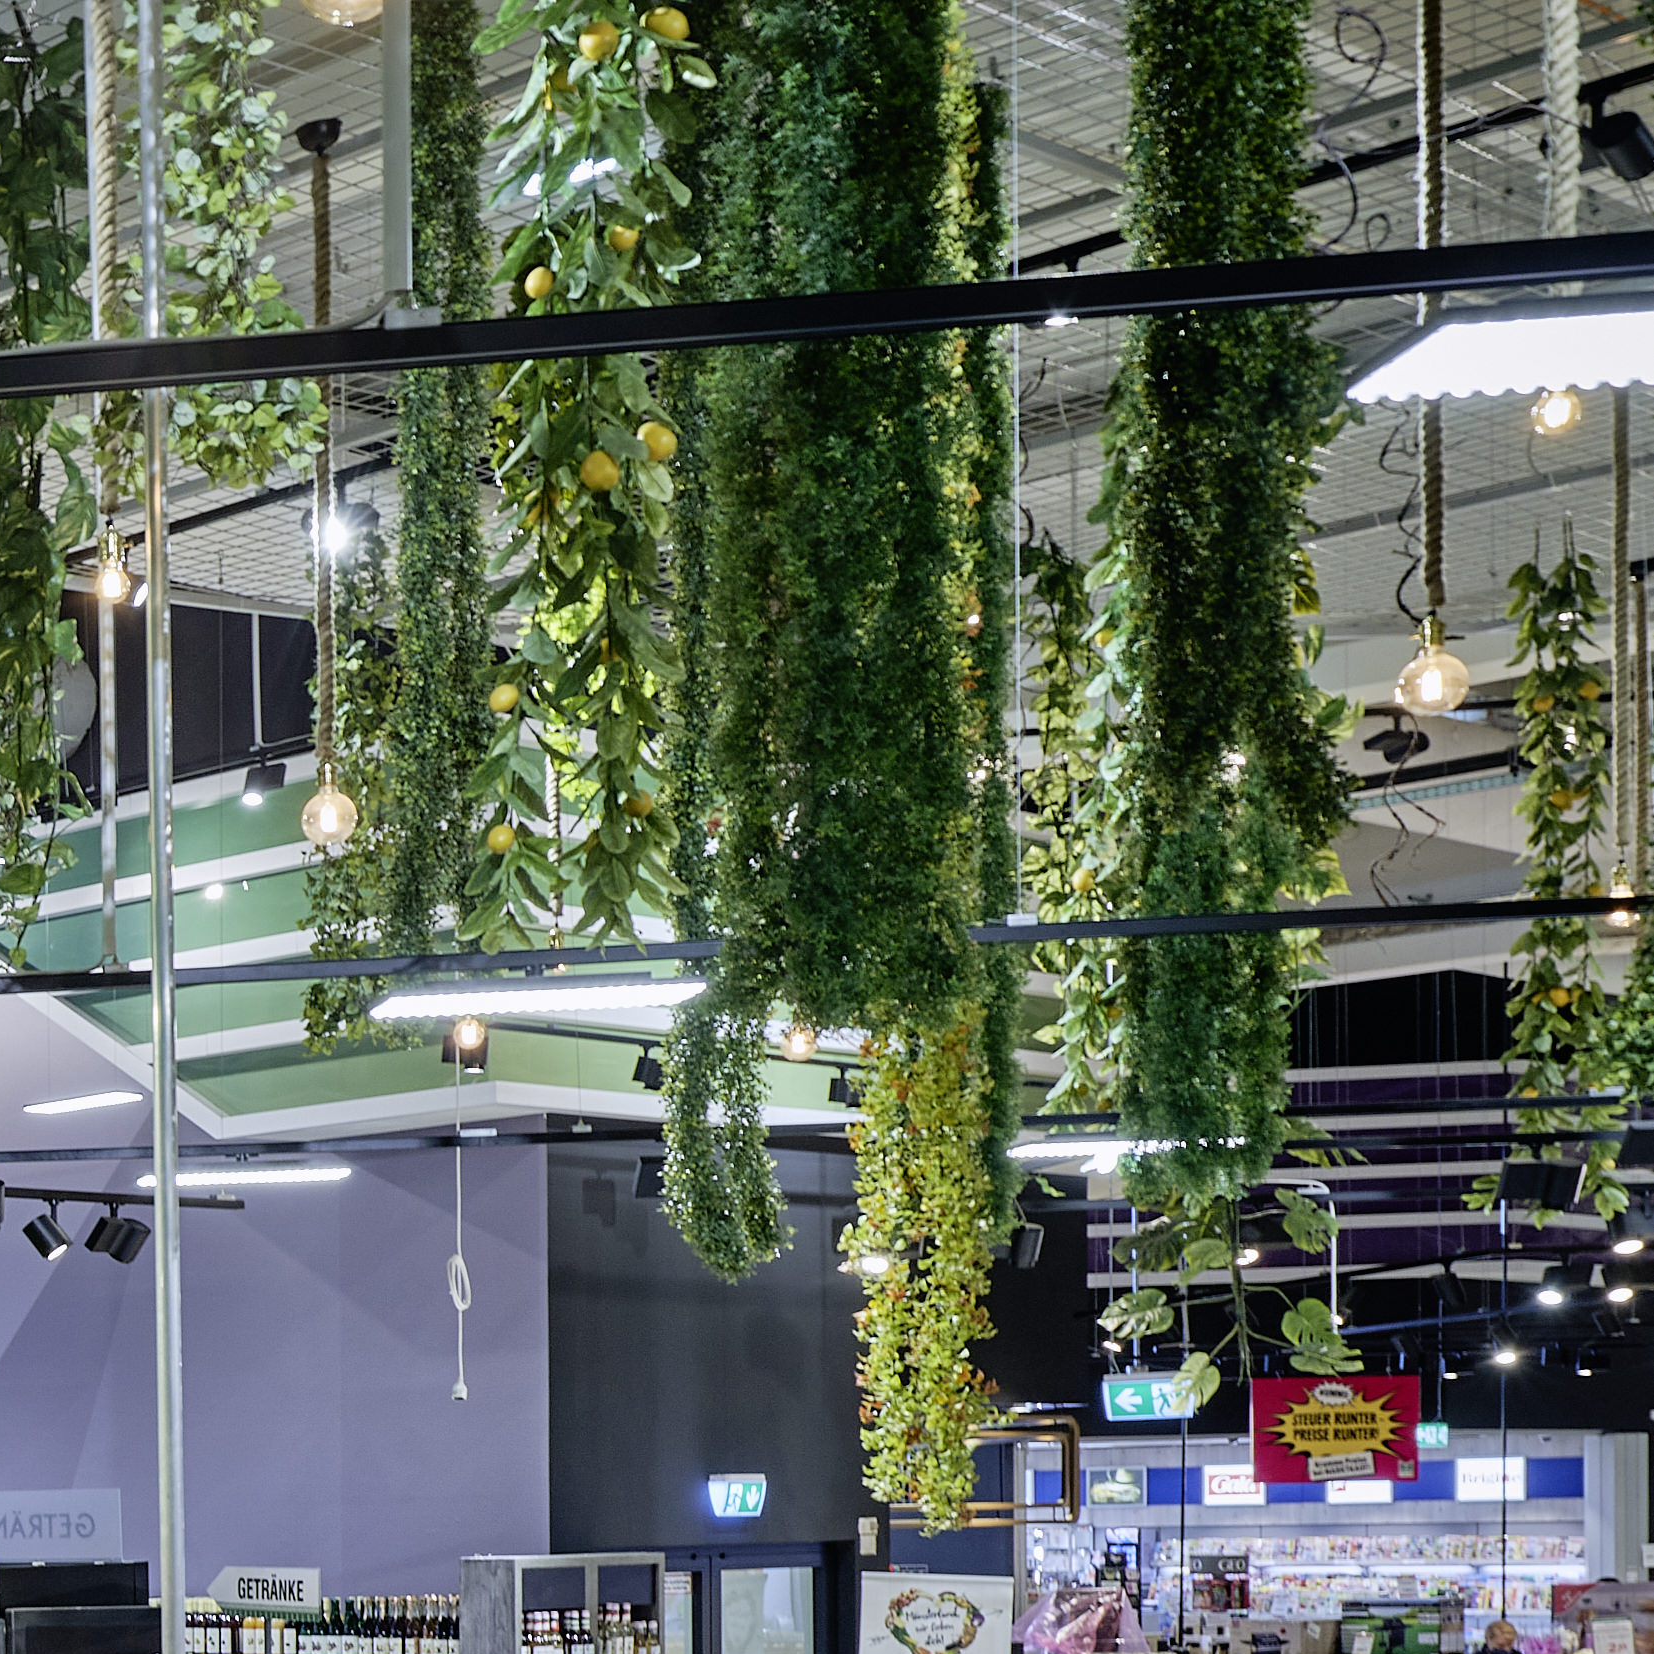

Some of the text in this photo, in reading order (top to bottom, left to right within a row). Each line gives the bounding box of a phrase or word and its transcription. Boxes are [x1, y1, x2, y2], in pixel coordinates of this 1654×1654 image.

[1293, 1412, 1377, 1426] STEUER RUNTER
[1294, 1429, 1330, 1441] PREISE
[237, 1574, 304, 1602] GETRÄNKE
